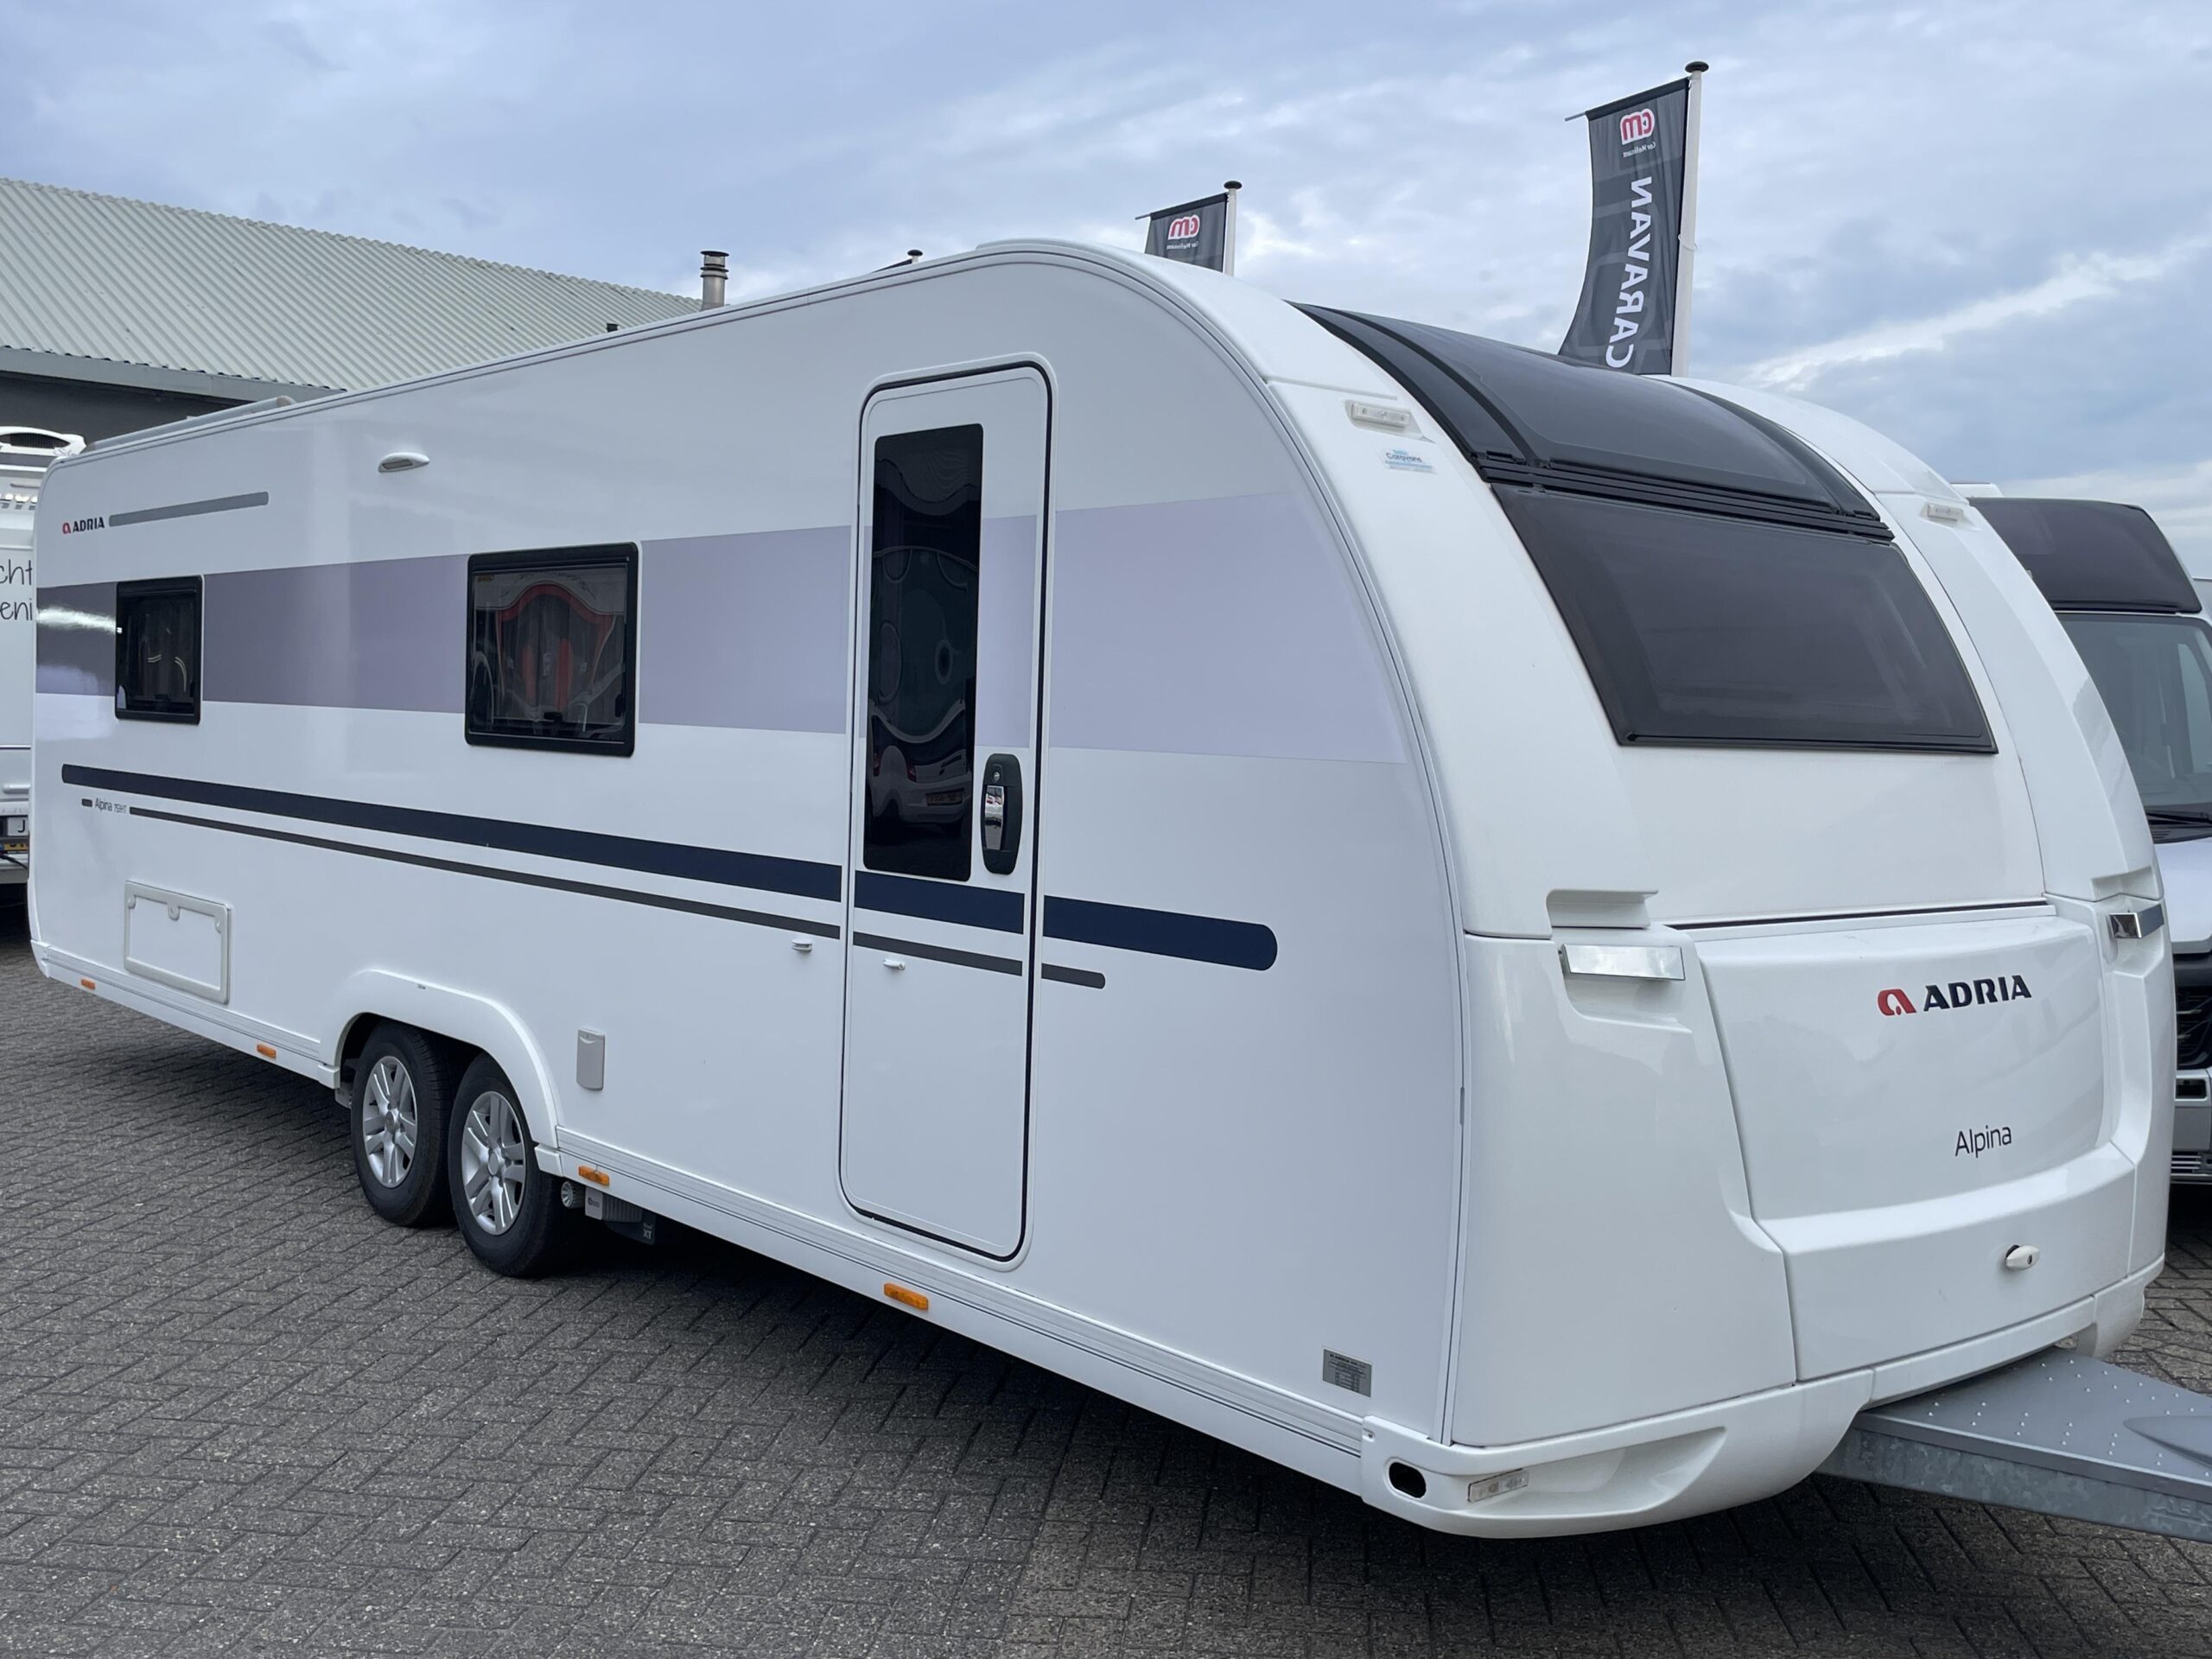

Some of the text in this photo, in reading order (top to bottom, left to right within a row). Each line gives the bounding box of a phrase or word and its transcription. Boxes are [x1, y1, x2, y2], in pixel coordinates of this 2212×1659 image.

[73, 517, 105, 533] ADRIA
[1923, 975, 2032, 1012] ADRIA
[1955, 1124, 2012, 1158] Alpina
